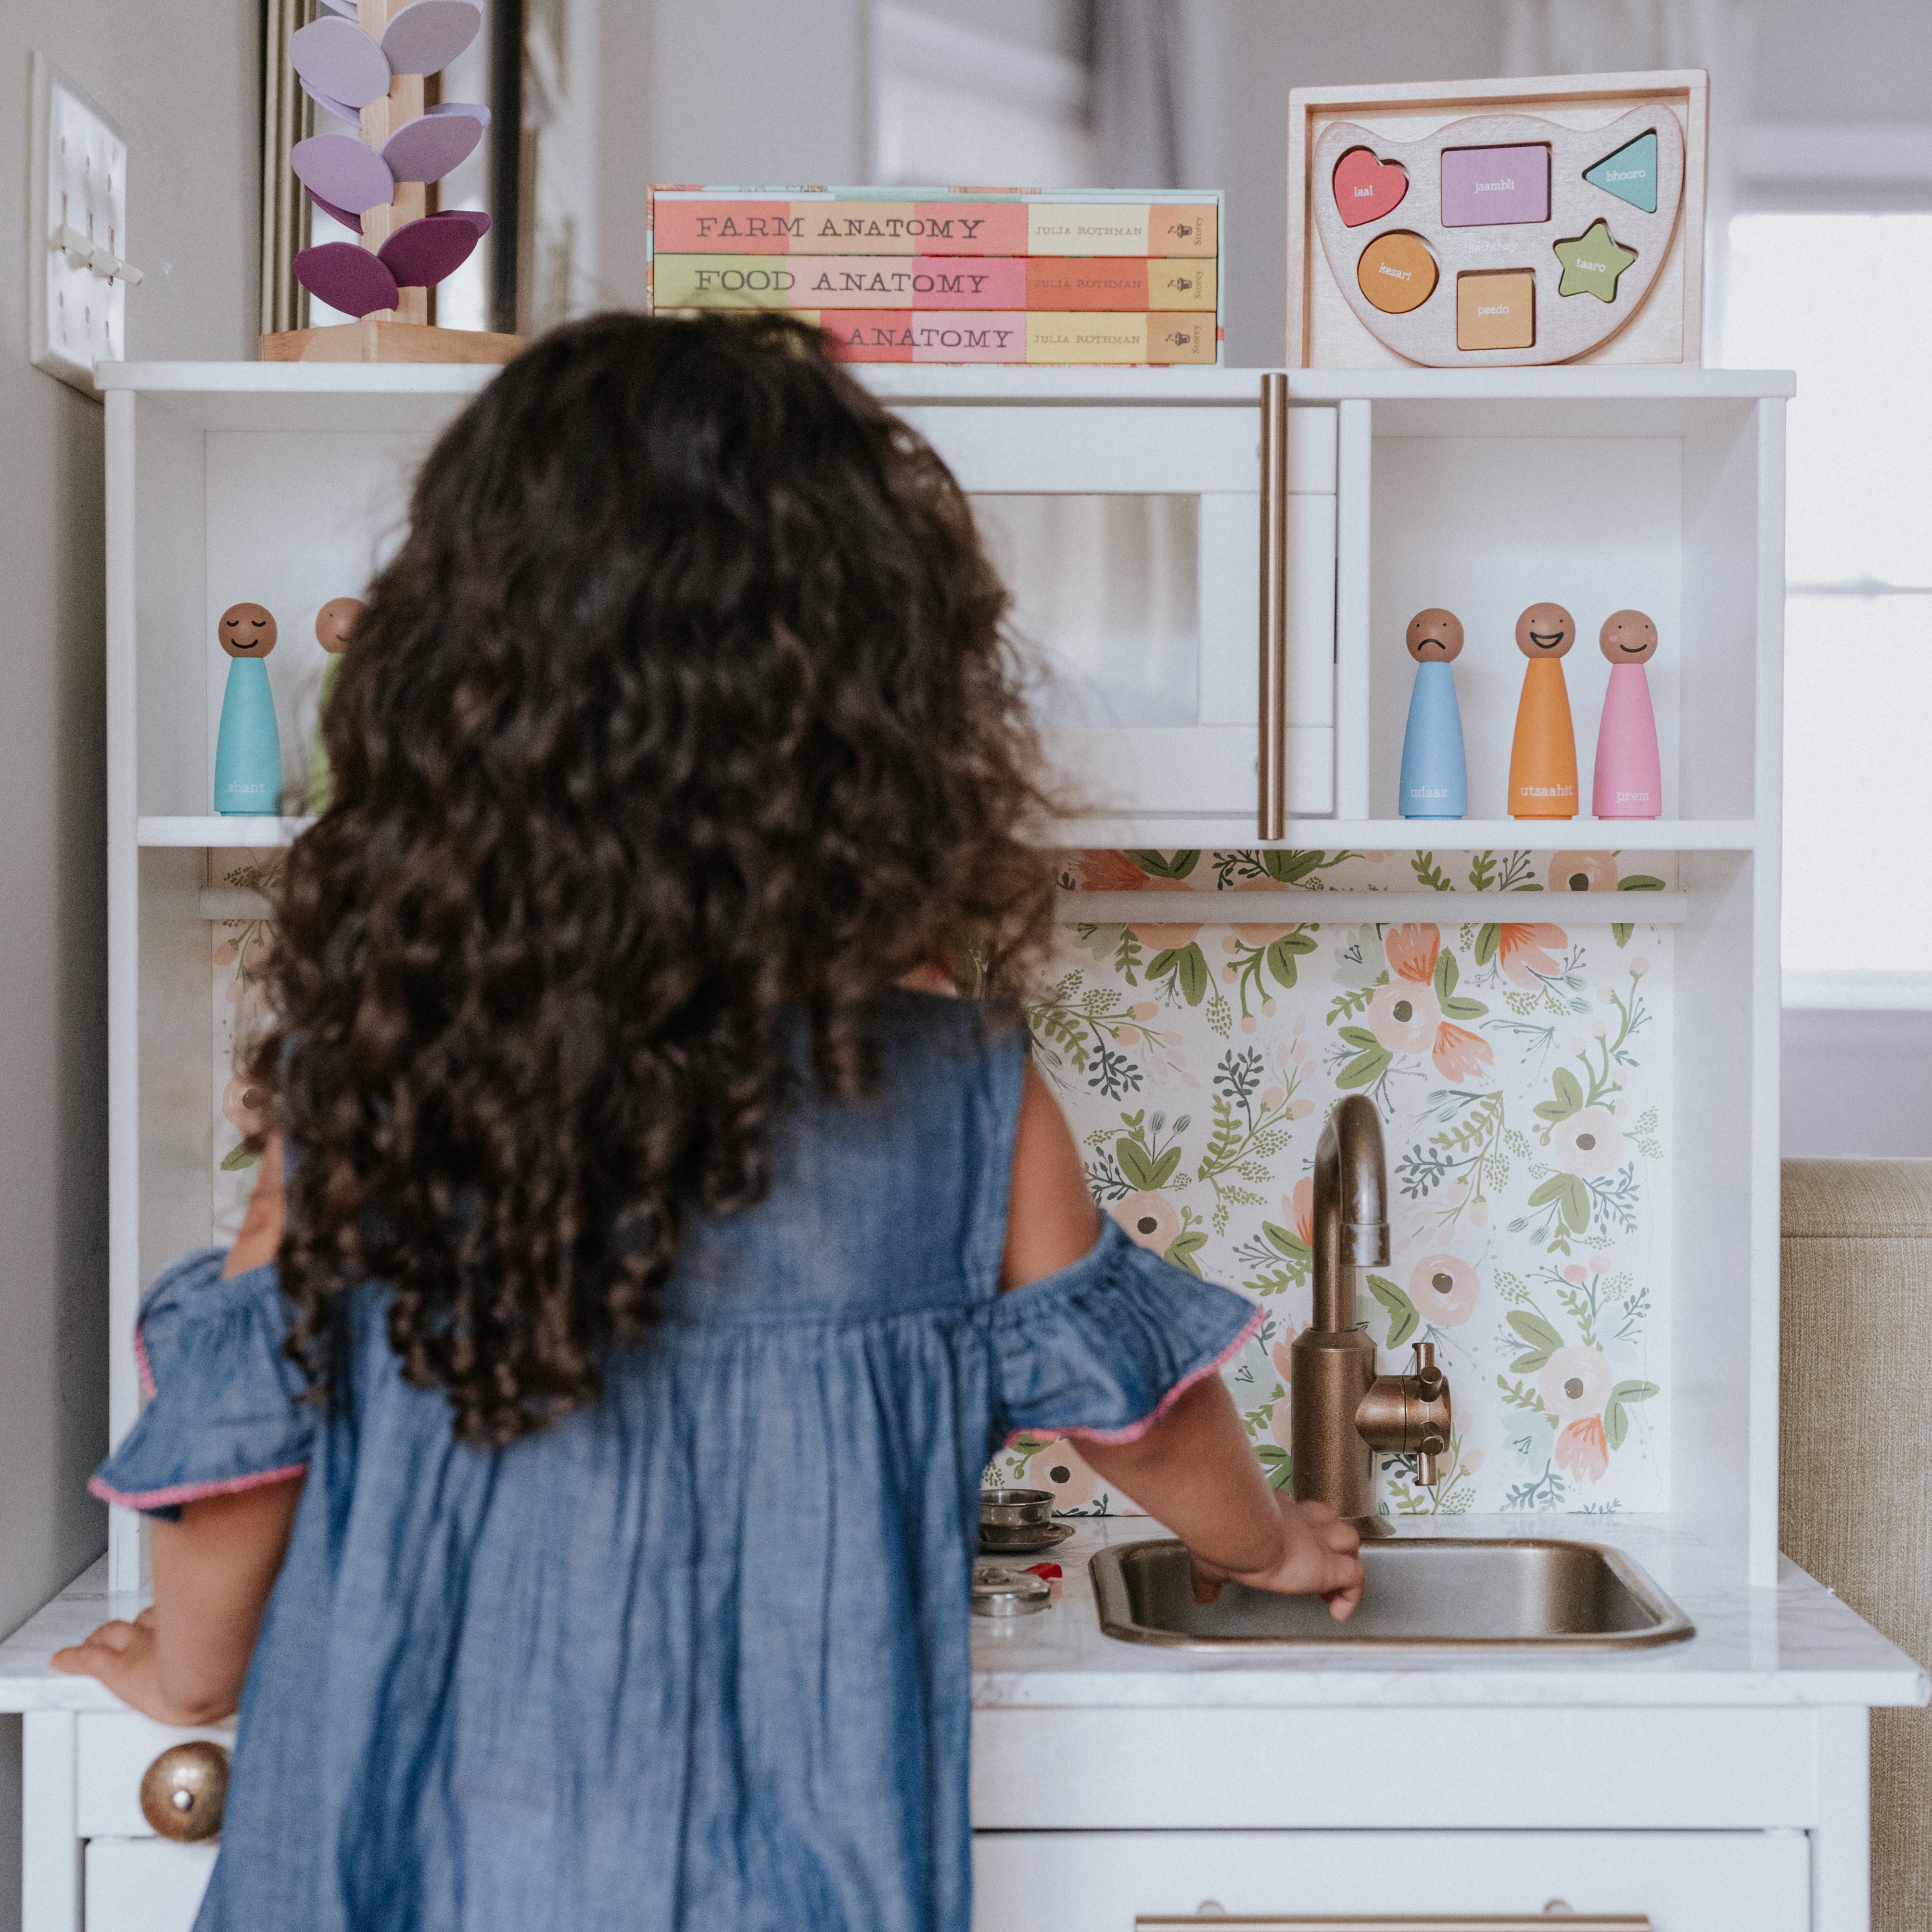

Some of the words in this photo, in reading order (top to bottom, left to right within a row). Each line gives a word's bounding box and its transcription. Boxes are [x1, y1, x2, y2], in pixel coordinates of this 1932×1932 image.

[1354, 185, 1373, 197] laal
[1474, 179, 1515, 194] jaambli
[696, 216, 805, 237] FARM
[817, 218, 985, 239] ANATOMY
[1035, 227, 1071, 235] JULIA
[1078, 227, 1144, 236] ROTHMAN
[1195, 216, 1205, 246] Storey
[1378, 262, 1412, 281] kesari
[1576, 258, 1607, 273] taaro
[695, 270, 795, 291] FOOD
[811, 273, 989, 293] ANATOMY
[1034, 280, 1070, 289] JULIA
[1077, 280, 1142, 289] ROTHMAN
[1194, 271, 1204, 300] Storey
[1478, 303, 1510, 317] peedo
[846, 328, 1014, 348] ANATOMY
[1033, 335, 1070, 343] JULIA
[1076, 335, 1141, 344] ROTHMAN
[1192, 325, 1202, 354] Storey
[227, 780, 265, 793] shant
[1410, 786, 1448, 798] udaas
[1520, 784, 1574, 797] utsaahit
[1616, 790, 1650, 803] prem
